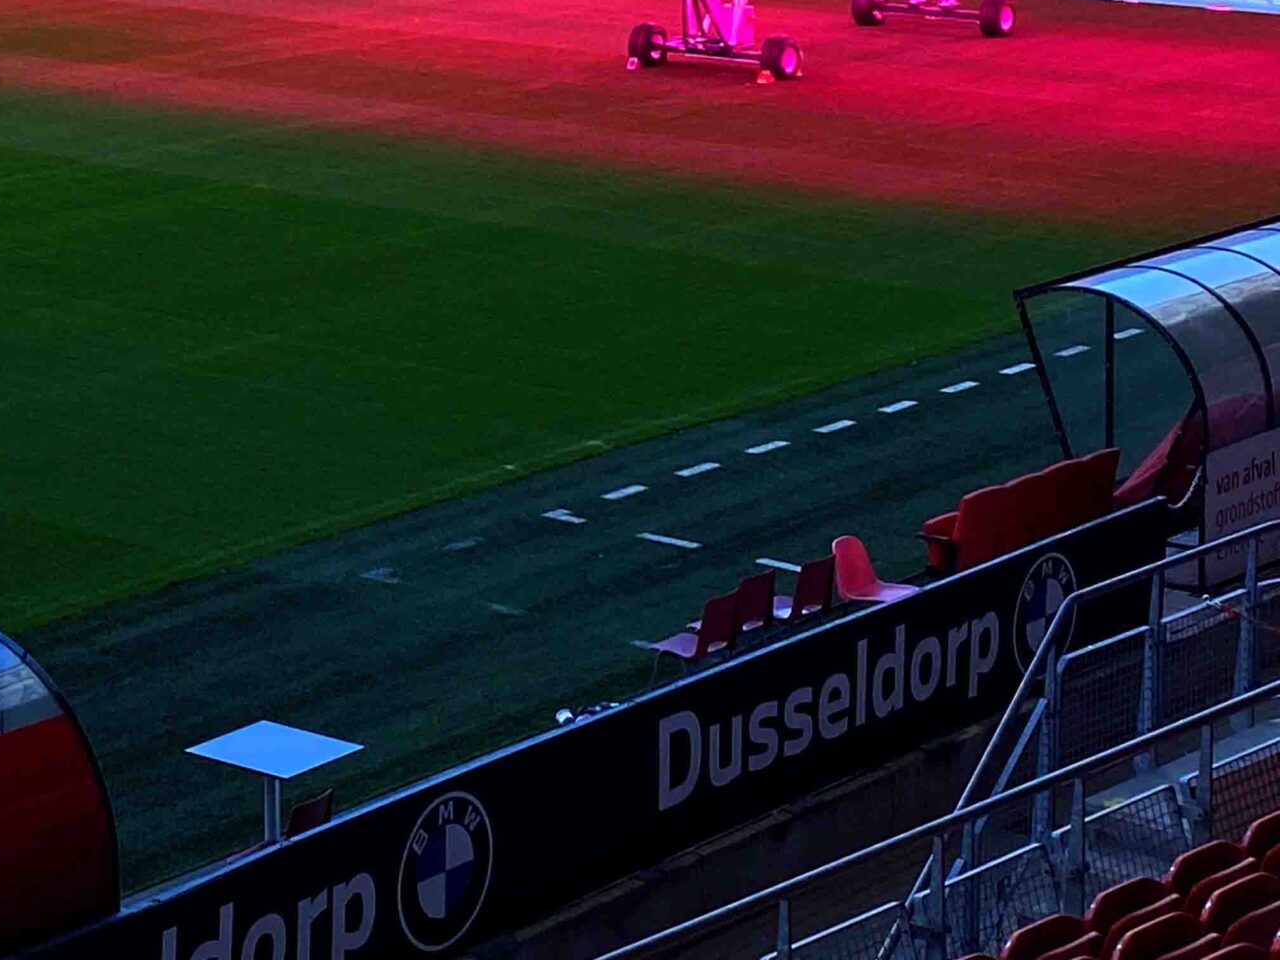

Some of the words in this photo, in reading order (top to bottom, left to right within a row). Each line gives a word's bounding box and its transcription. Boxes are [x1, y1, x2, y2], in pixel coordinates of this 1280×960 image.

[1216, 469, 1240, 495] van
[1243, 451, 1276, 485] afval
[1023, 559, 1071, 601] BMW
[658, 610, 1000, 811] Dusseldorp
[412, 800, 481, 855] BMW
